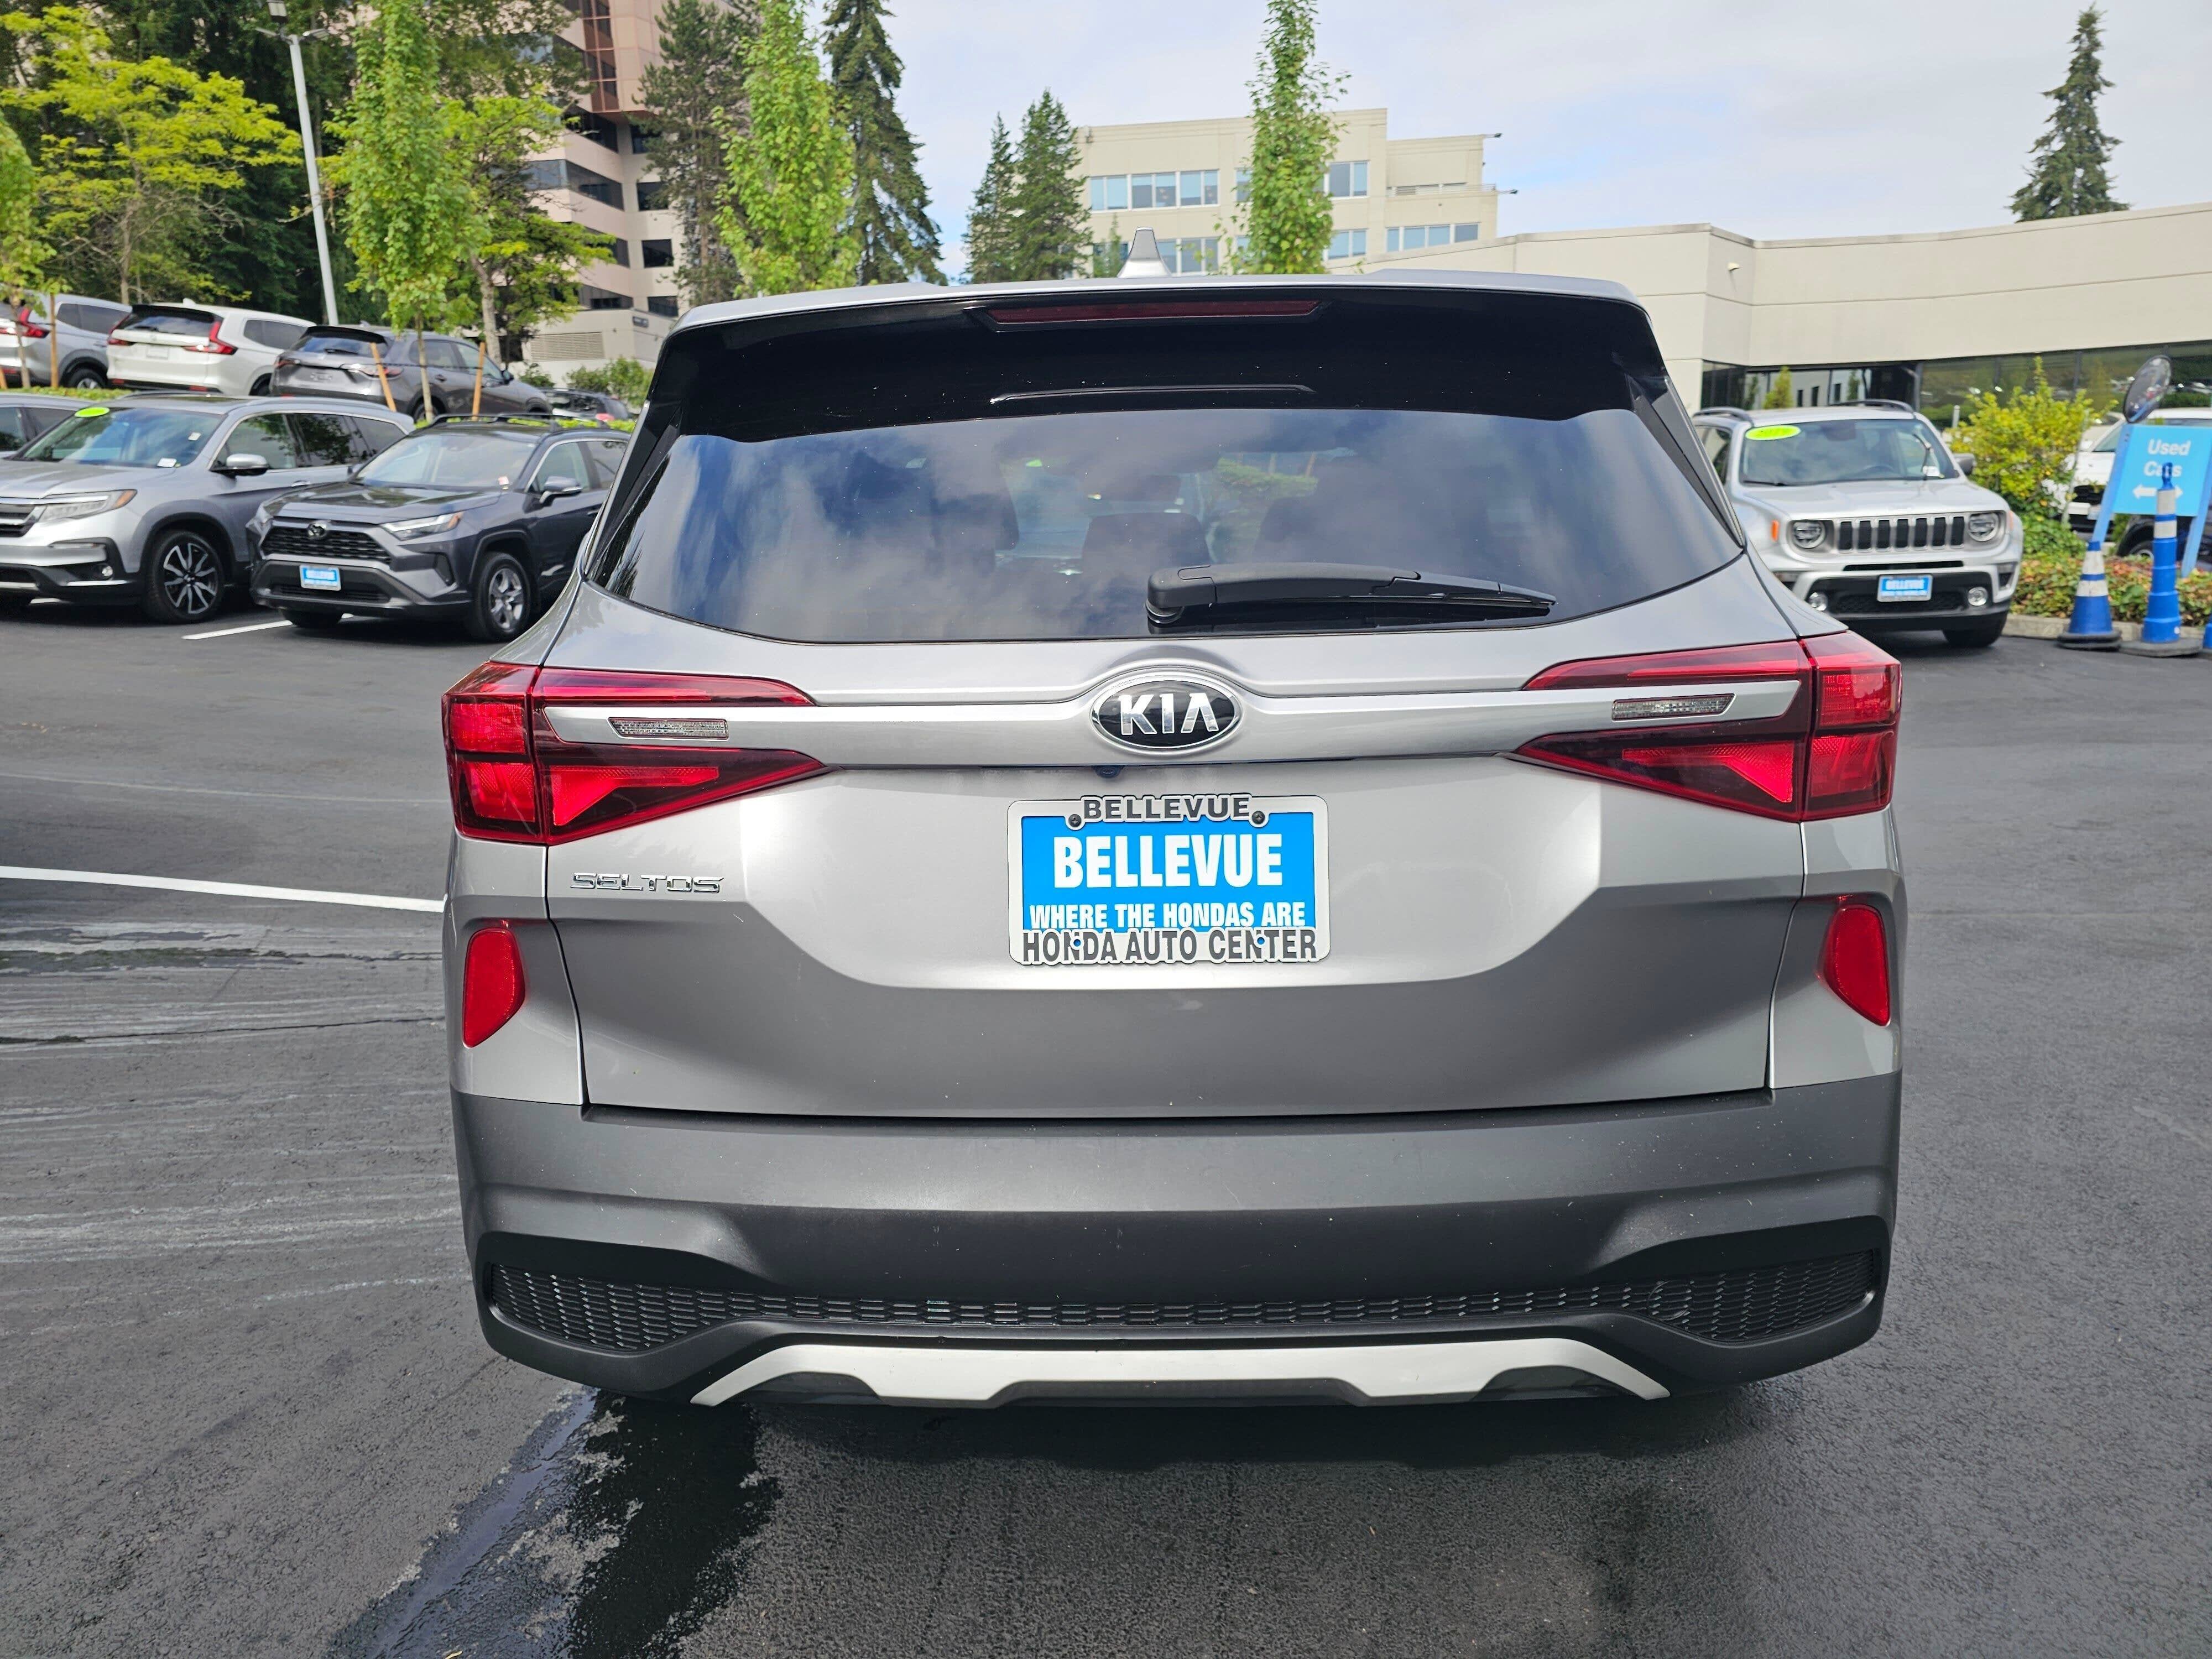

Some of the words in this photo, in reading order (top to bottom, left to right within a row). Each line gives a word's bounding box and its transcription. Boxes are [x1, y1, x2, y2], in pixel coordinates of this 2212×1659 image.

[2148, 439, 2192, 456] Used
[1118, 693, 1219, 735] KIA
[1084, 797, 1250, 820] BELLEVUE
[1053, 833, 1283, 888] BELLEVUE
[570, 872, 725, 893] SELTOS
[1030, 904, 1108, 929] WHERE
[1114, 903, 1155, 928] THE
[1163, 902, 1255, 927] HONDAS
[1261, 901, 1306, 926] ARE
[1023, 931, 1118, 962] HONDA
[1126, 930, 1198, 961] AUTO
[1208, 930, 1316, 960] CENTER
